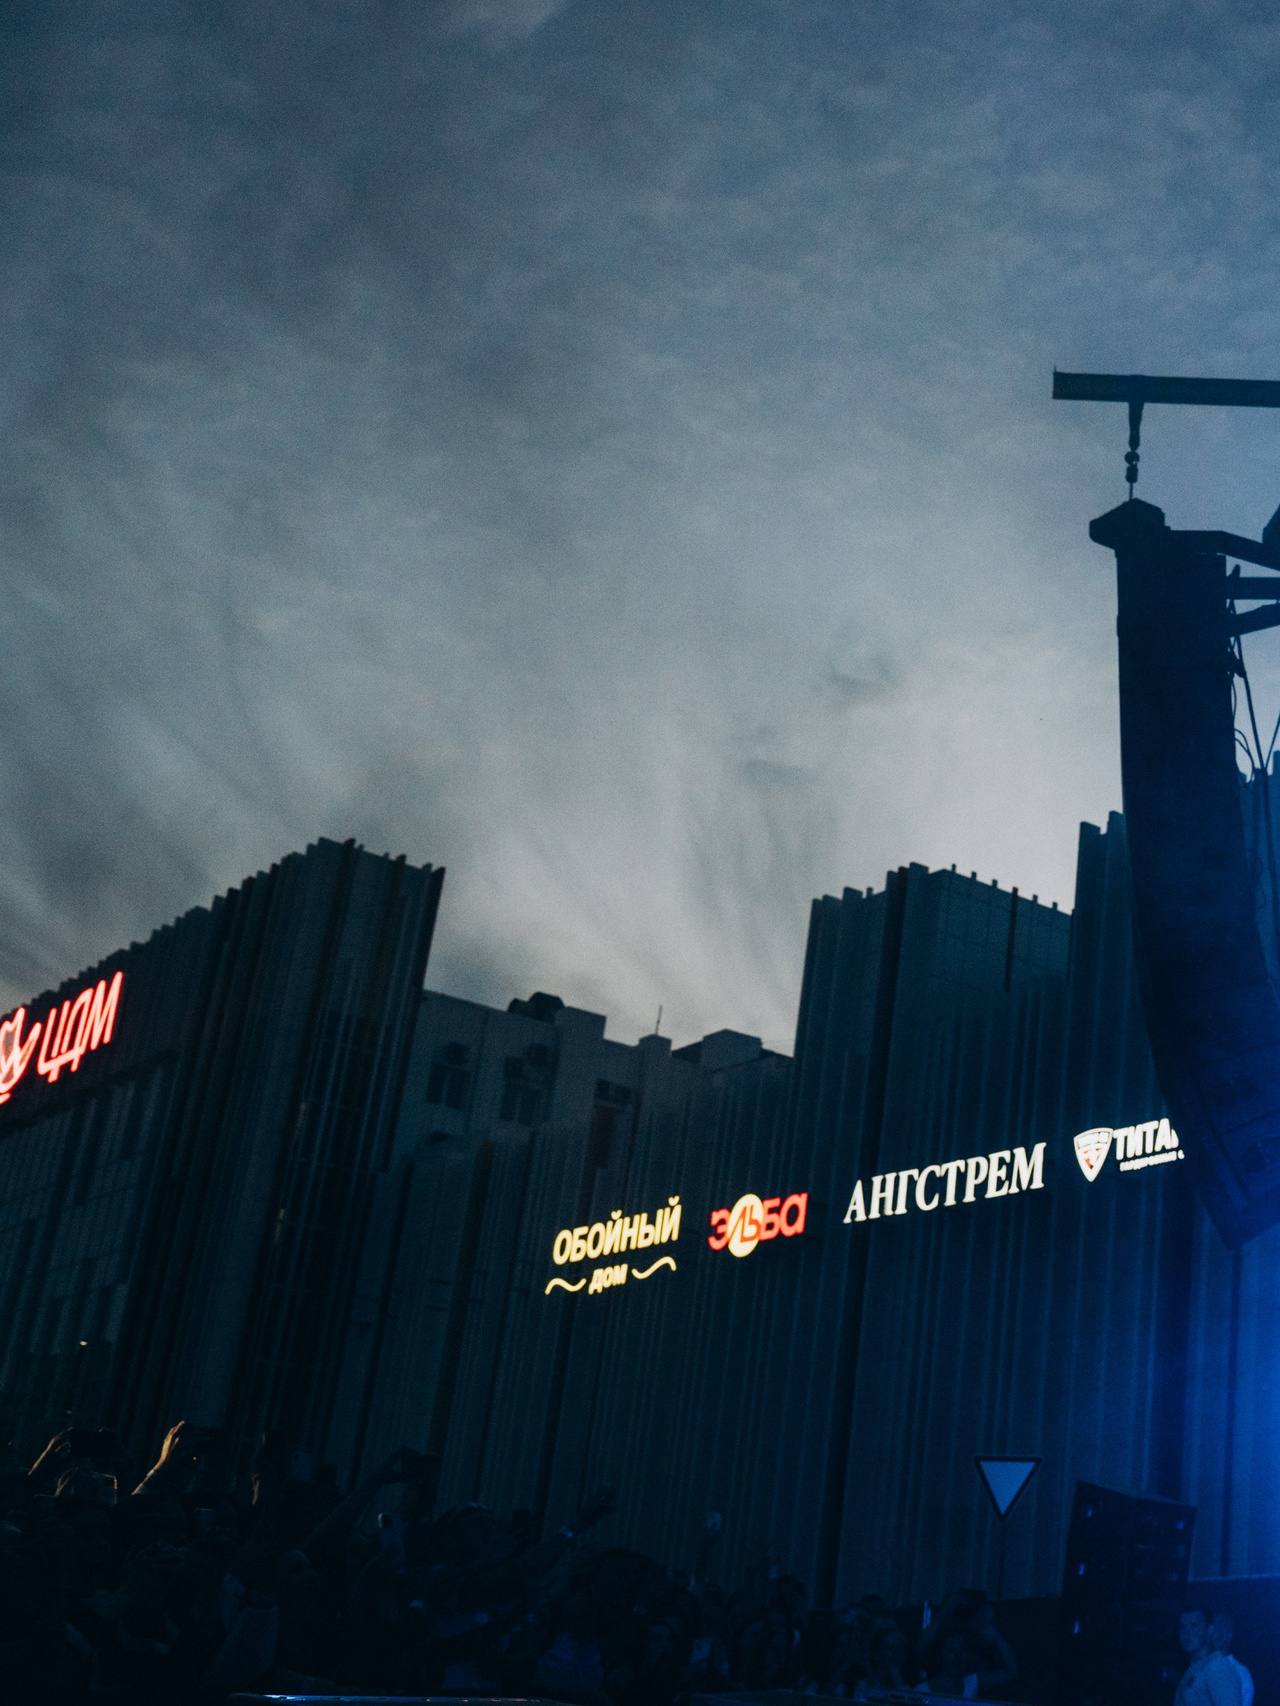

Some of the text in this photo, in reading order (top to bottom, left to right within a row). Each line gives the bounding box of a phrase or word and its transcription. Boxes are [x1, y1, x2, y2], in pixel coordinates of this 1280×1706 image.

[38, 970, 124, 1083] ЦДМ
[843, 1142, 1047, 1224] АНГСТРЕМ
[552, 1195, 682, 1265] ОБОЙНЫЙ
